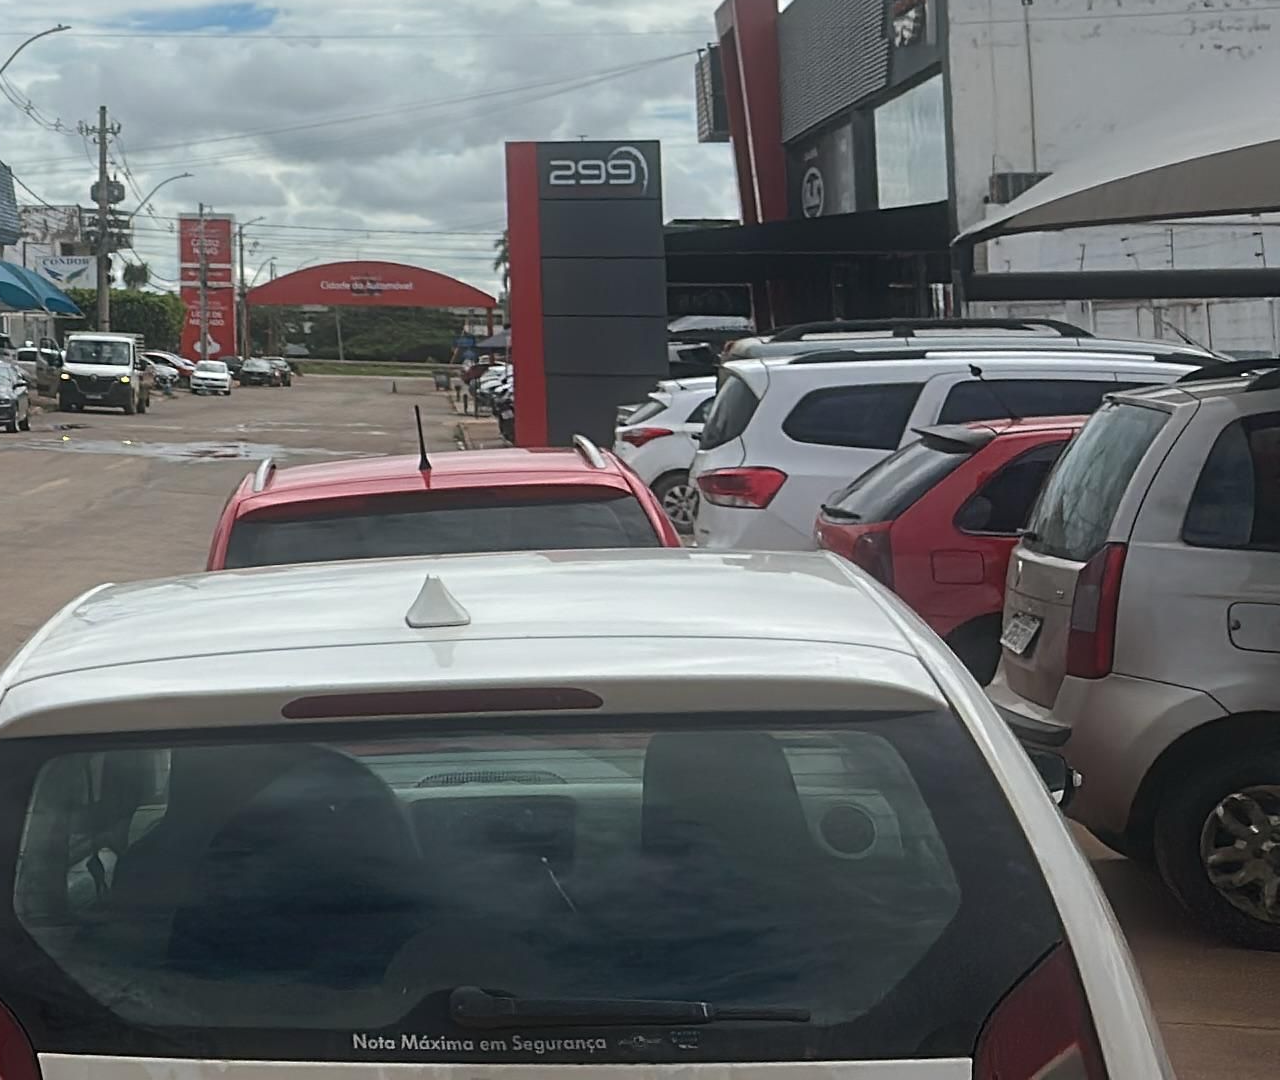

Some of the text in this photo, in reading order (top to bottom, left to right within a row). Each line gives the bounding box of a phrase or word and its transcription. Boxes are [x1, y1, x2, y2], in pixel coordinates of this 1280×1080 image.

[549, 159, 637, 185] 299
[352, 1033, 396, 1050] Nota
[400, 1032, 475, 1052] Máxima
[479, 1038, 507, 1052] em
[511, 1034, 608, 1055] Segurança
